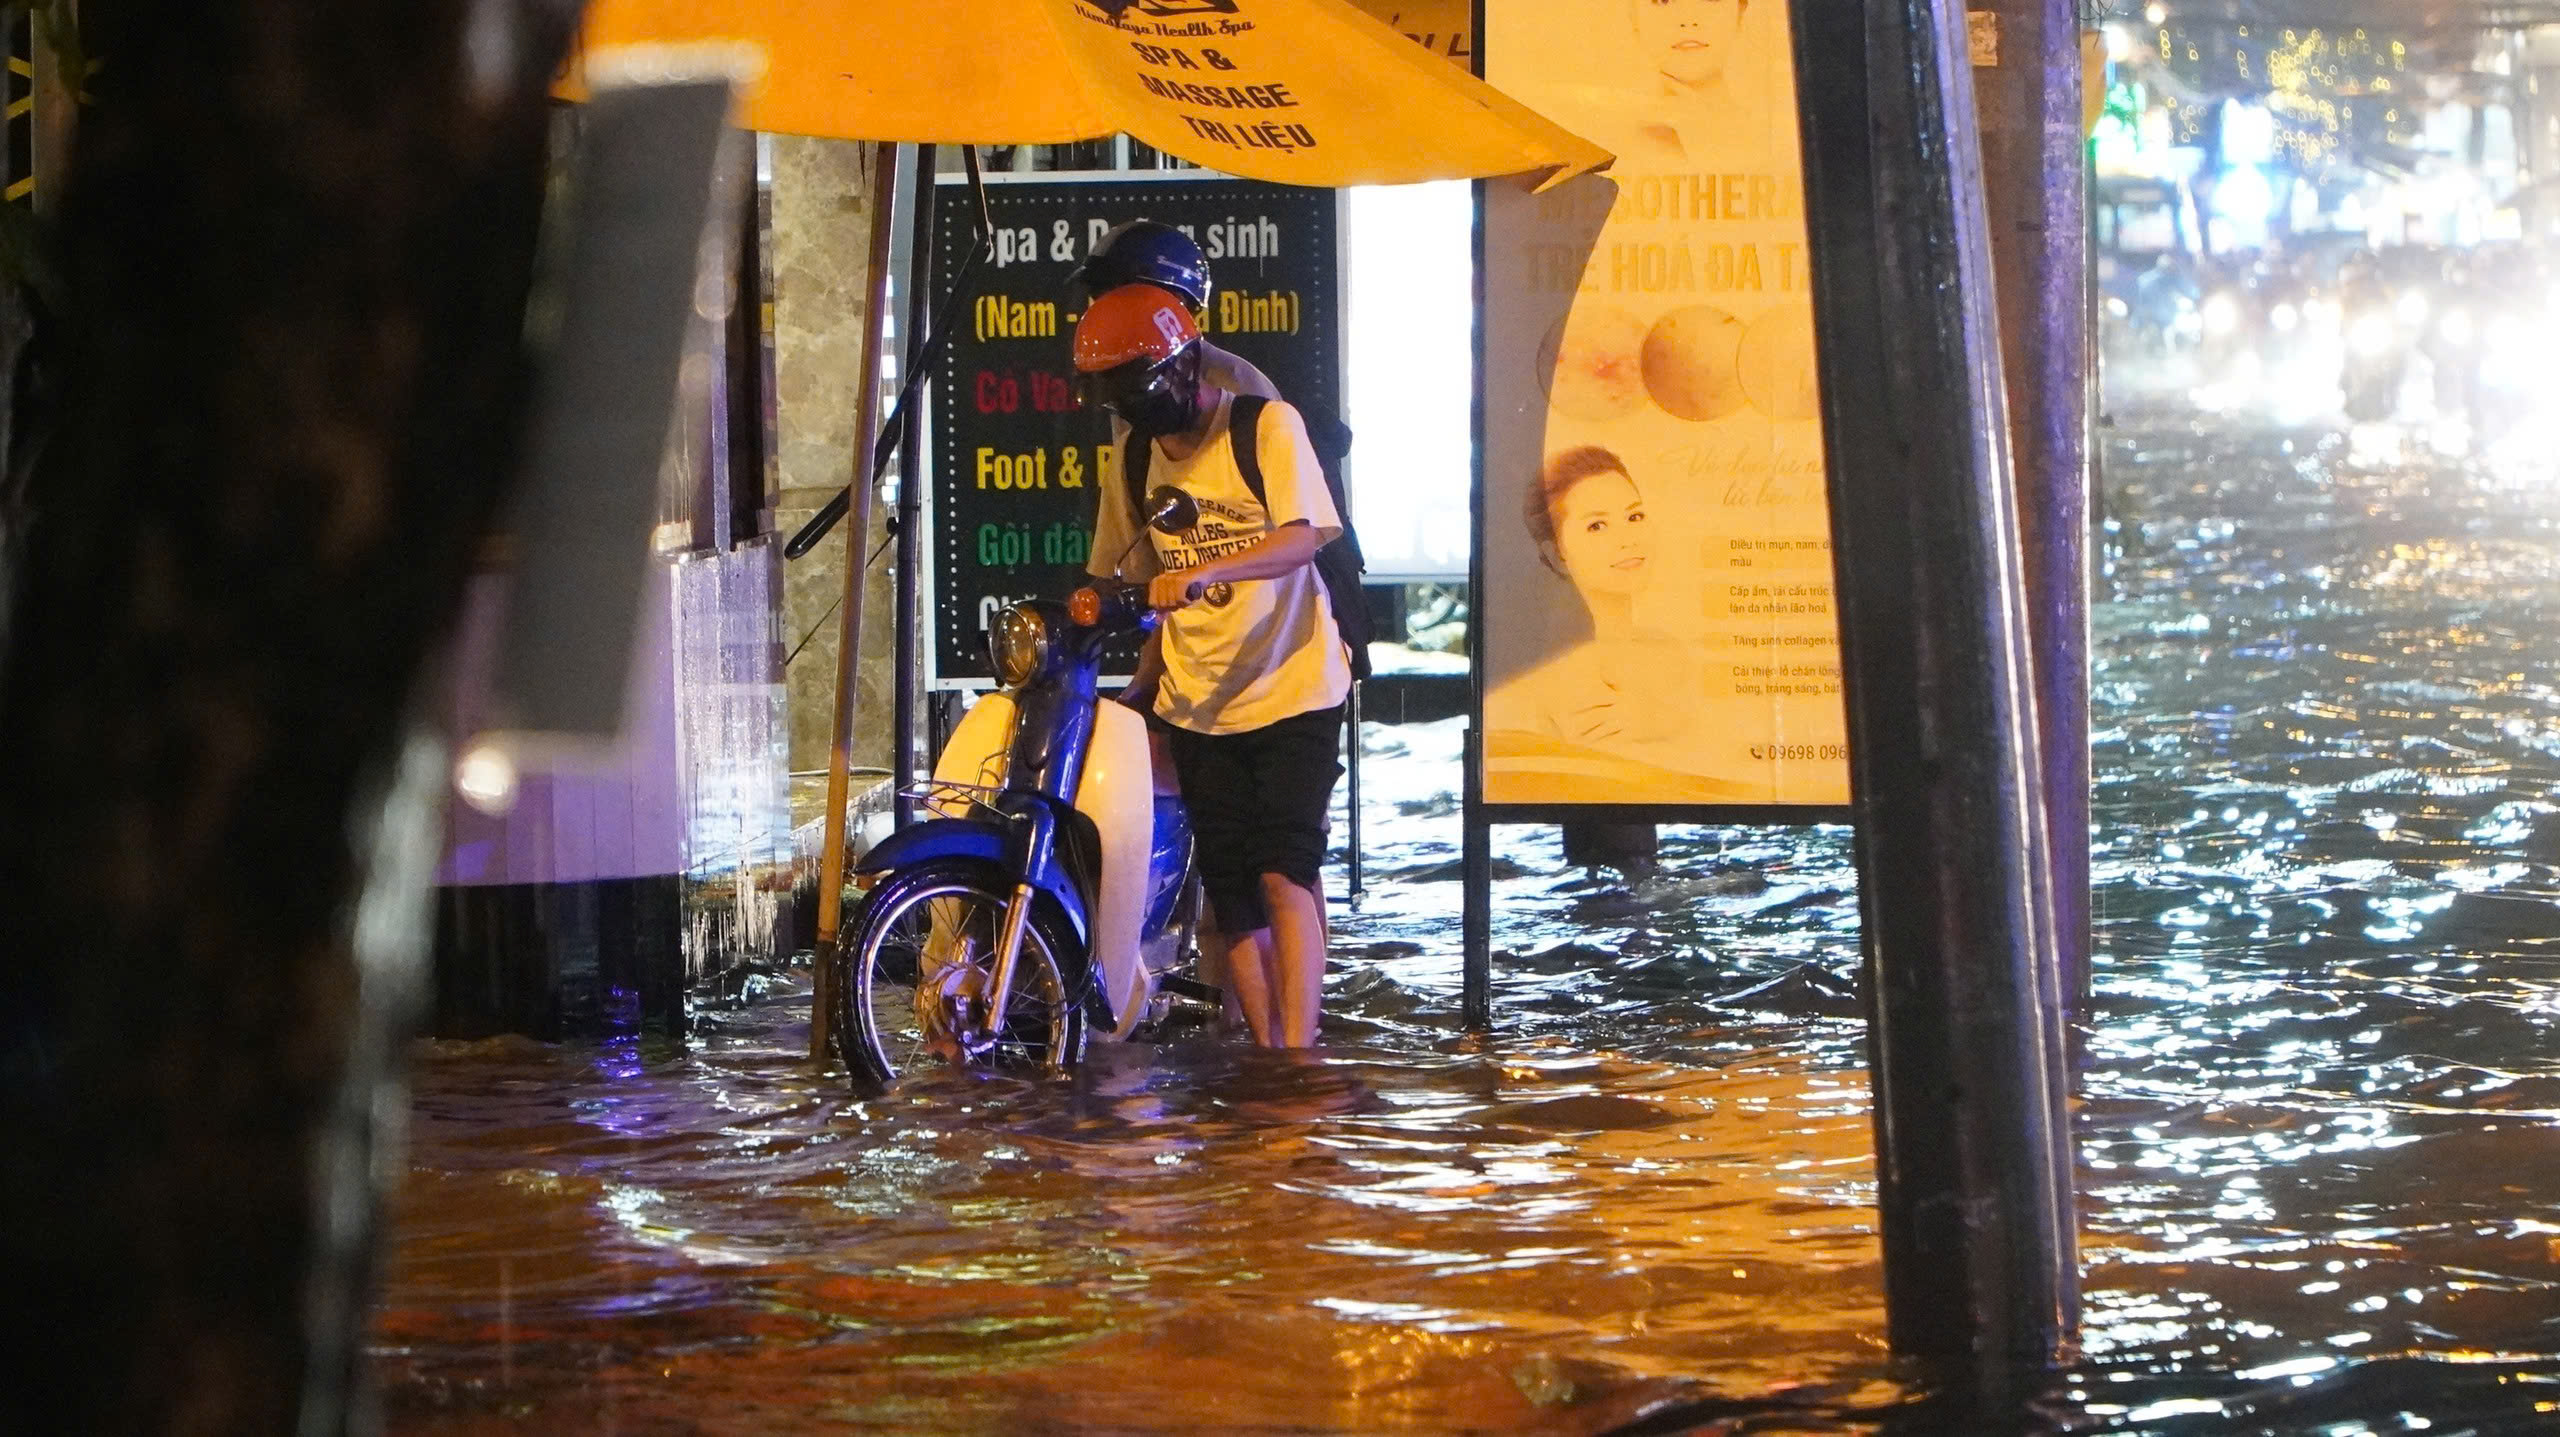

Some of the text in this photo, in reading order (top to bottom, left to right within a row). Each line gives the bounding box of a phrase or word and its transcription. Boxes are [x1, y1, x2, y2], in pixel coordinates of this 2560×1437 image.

[1073, 4, 1256, 37] Himalaya Health Spa
[1131, 41, 1238, 71] SPA &
[1137, 72, 1298, 109] MASSAGE
[1180, 114, 1317, 154] TRỊ LIỆU
[1050, 219, 1075, 261] &
[1207, 215, 1278, 259] sinh
[975, 295, 1056, 343] (Nam
[1031, 371, 1081, 413] Va
[977, 447, 1047, 489] Foot
[1058, 446, 1083, 487] &
[1197, 498, 1247, 524] CENCE
[978, 520, 1032, 575] Gội
[1784, 635, 1826, 647] collagen
[1768, 744, 1815, 760] 09698
